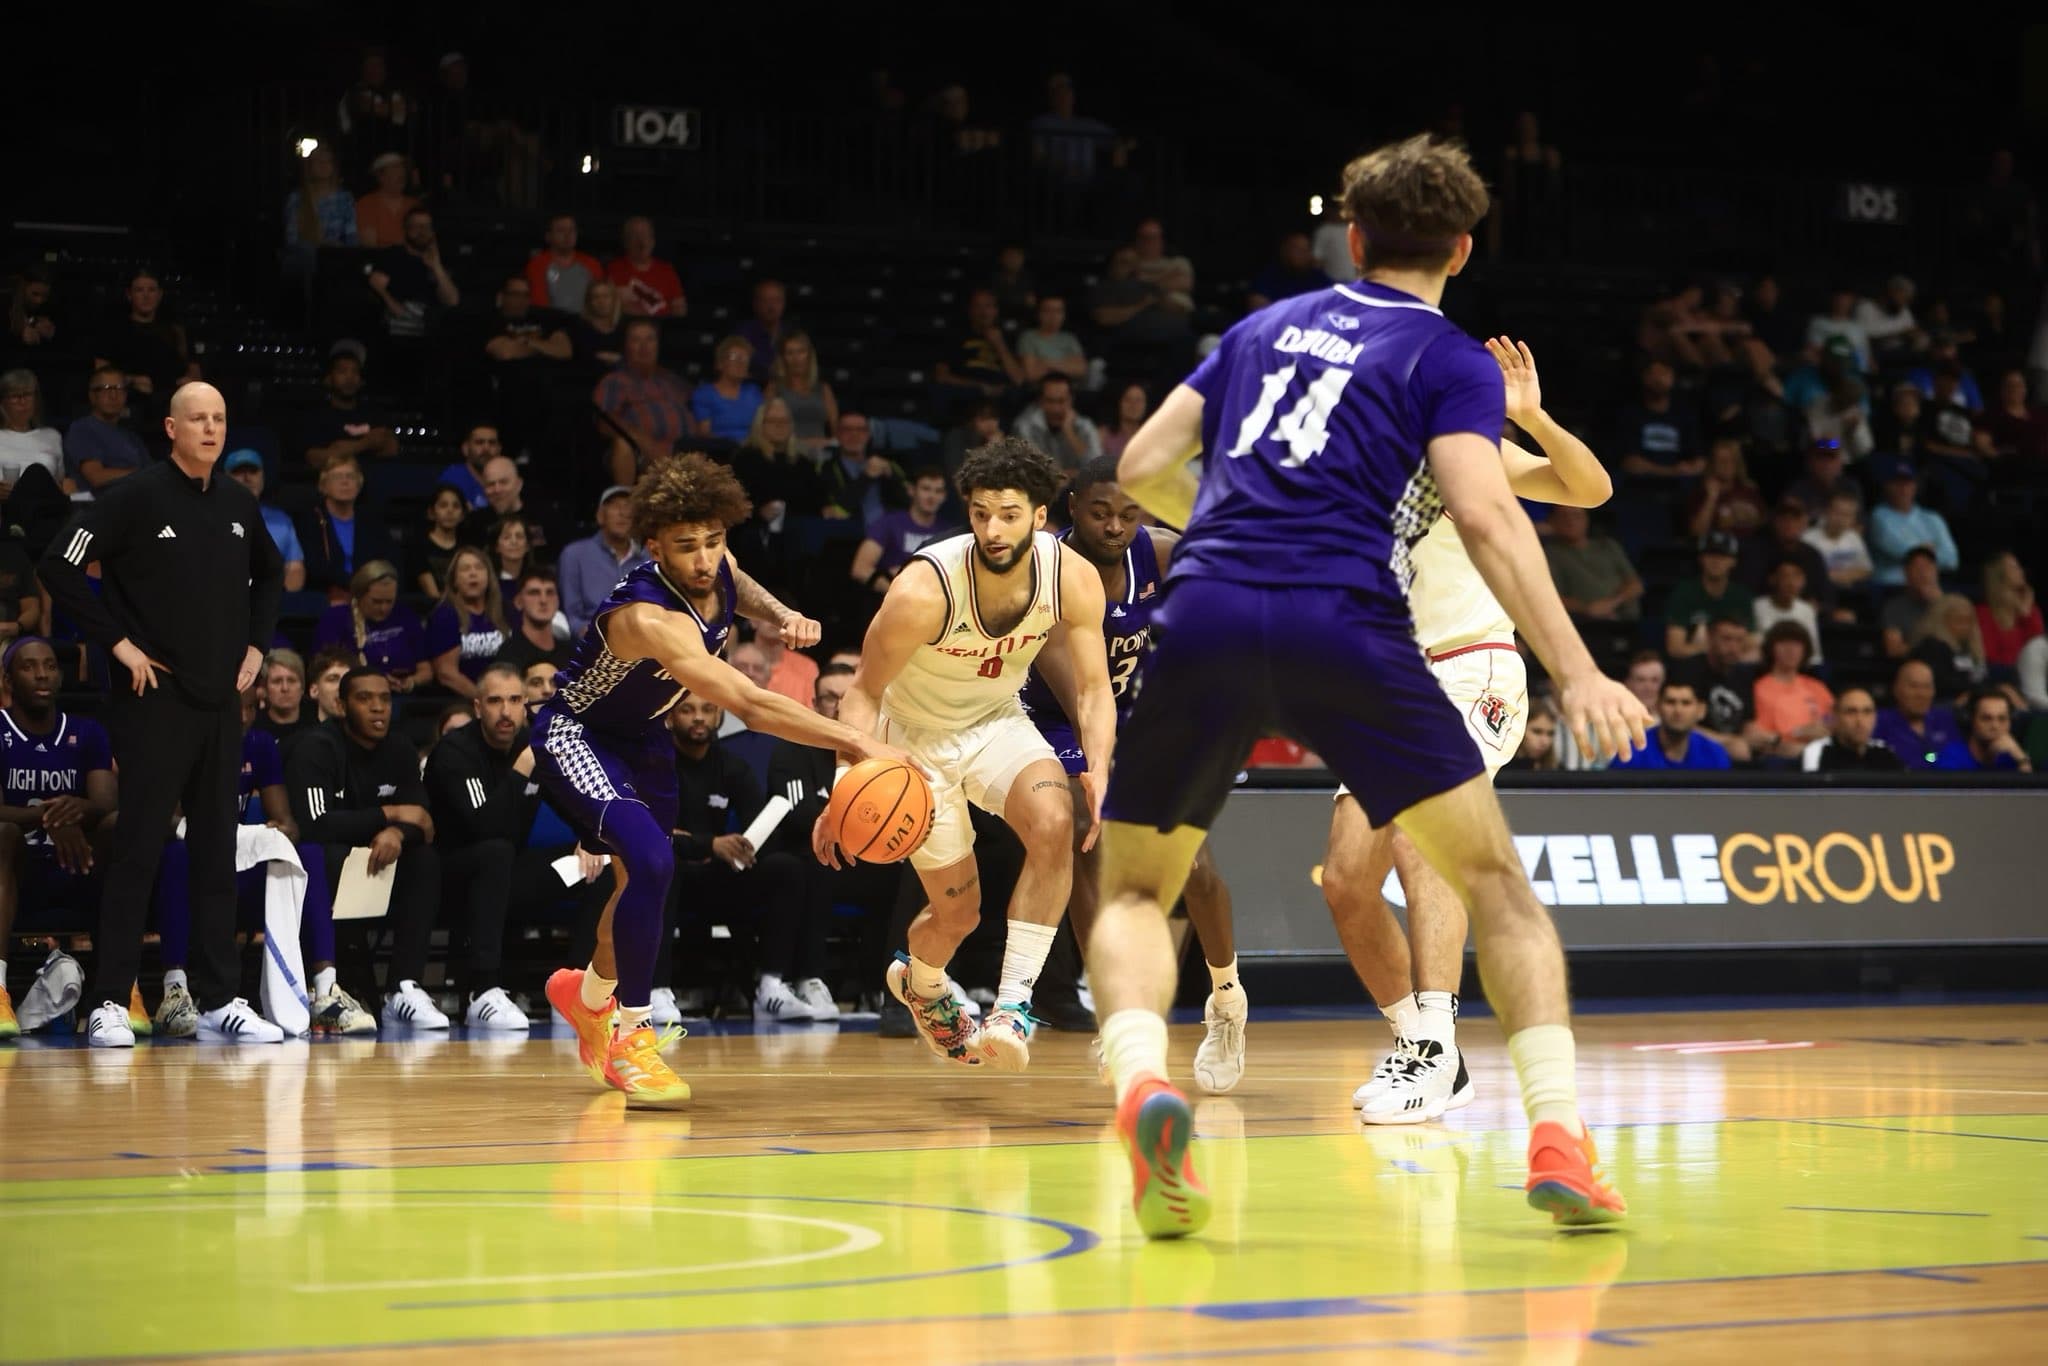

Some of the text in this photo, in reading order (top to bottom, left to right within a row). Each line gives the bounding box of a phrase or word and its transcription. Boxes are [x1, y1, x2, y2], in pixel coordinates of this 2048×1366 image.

[624, 110, 689, 145] 104
[1849, 186, 1898, 219] 105
[1226, 360, 1353, 468] 14
